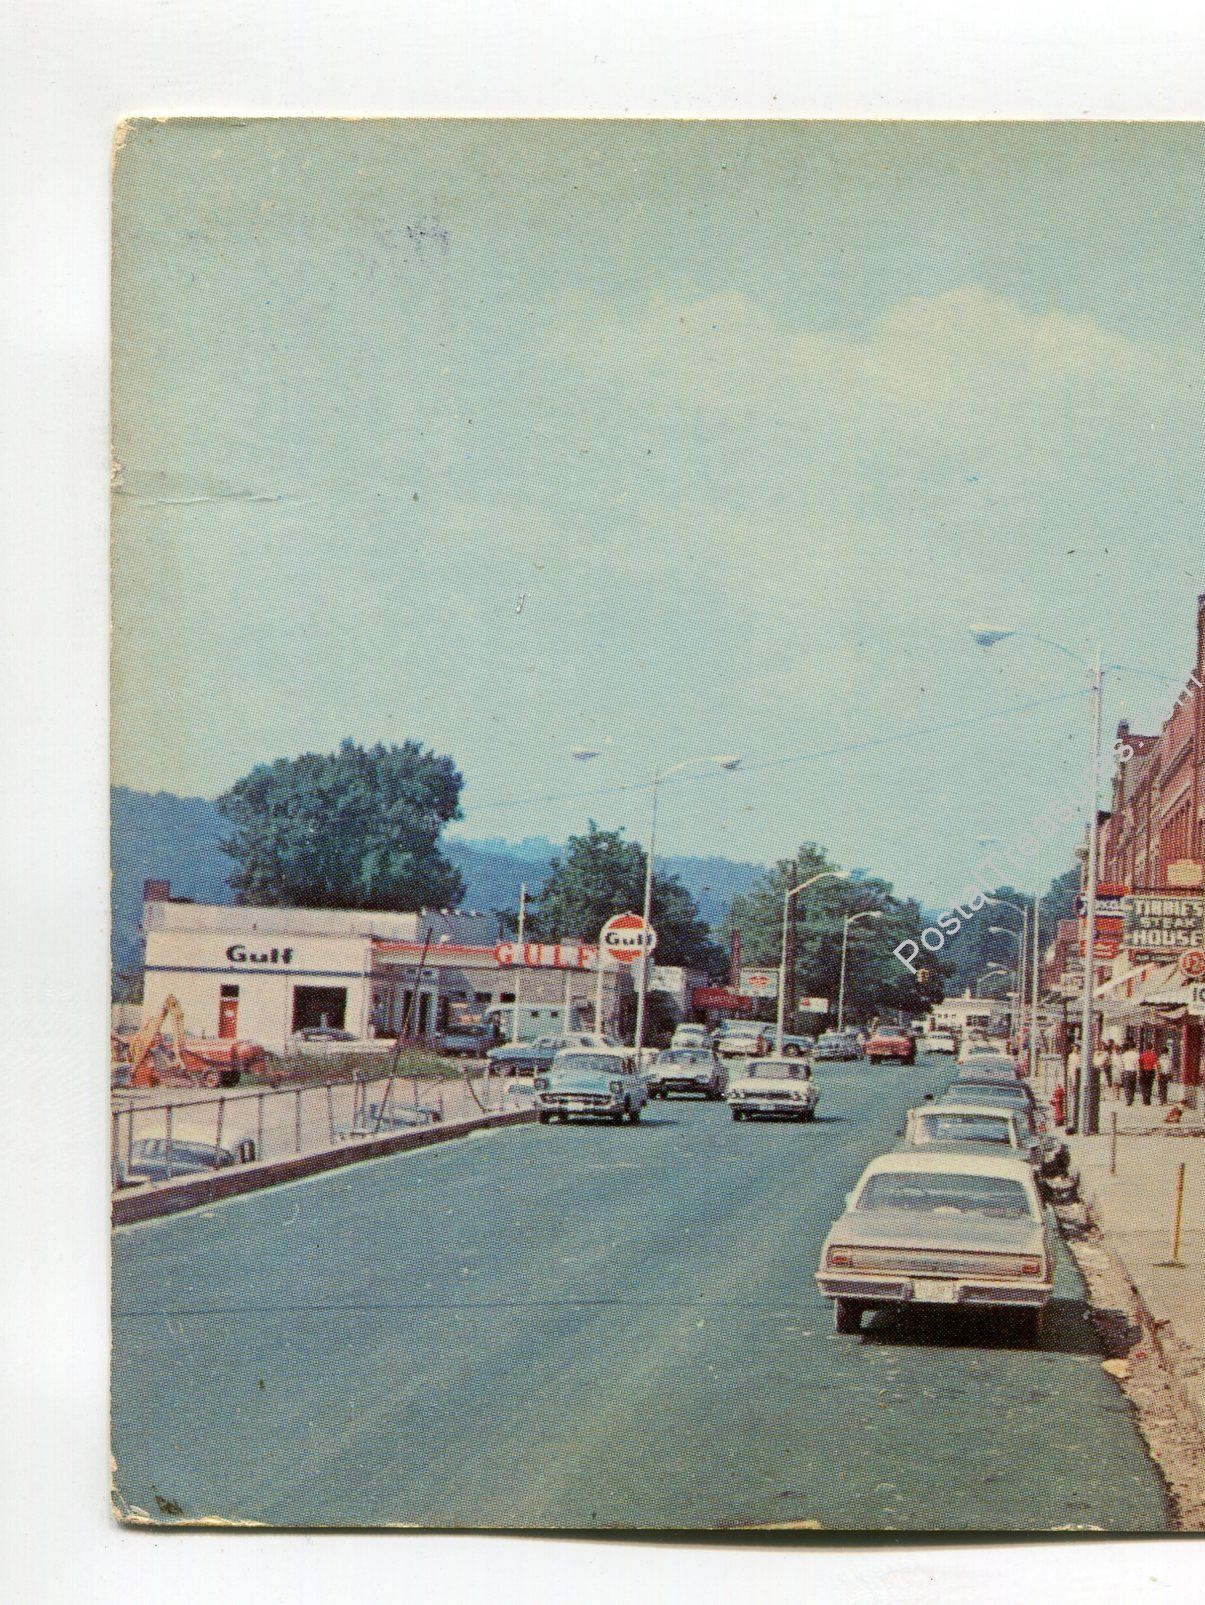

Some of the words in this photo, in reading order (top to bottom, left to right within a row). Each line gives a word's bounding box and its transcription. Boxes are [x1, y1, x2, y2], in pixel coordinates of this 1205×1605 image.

[1140, 917, 1197, 928] STEAK
[1133, 929, 1203, 946] HOUSE
[225, 943, 294, 964] Gulf
[494, 940, 597, 968] GULF
